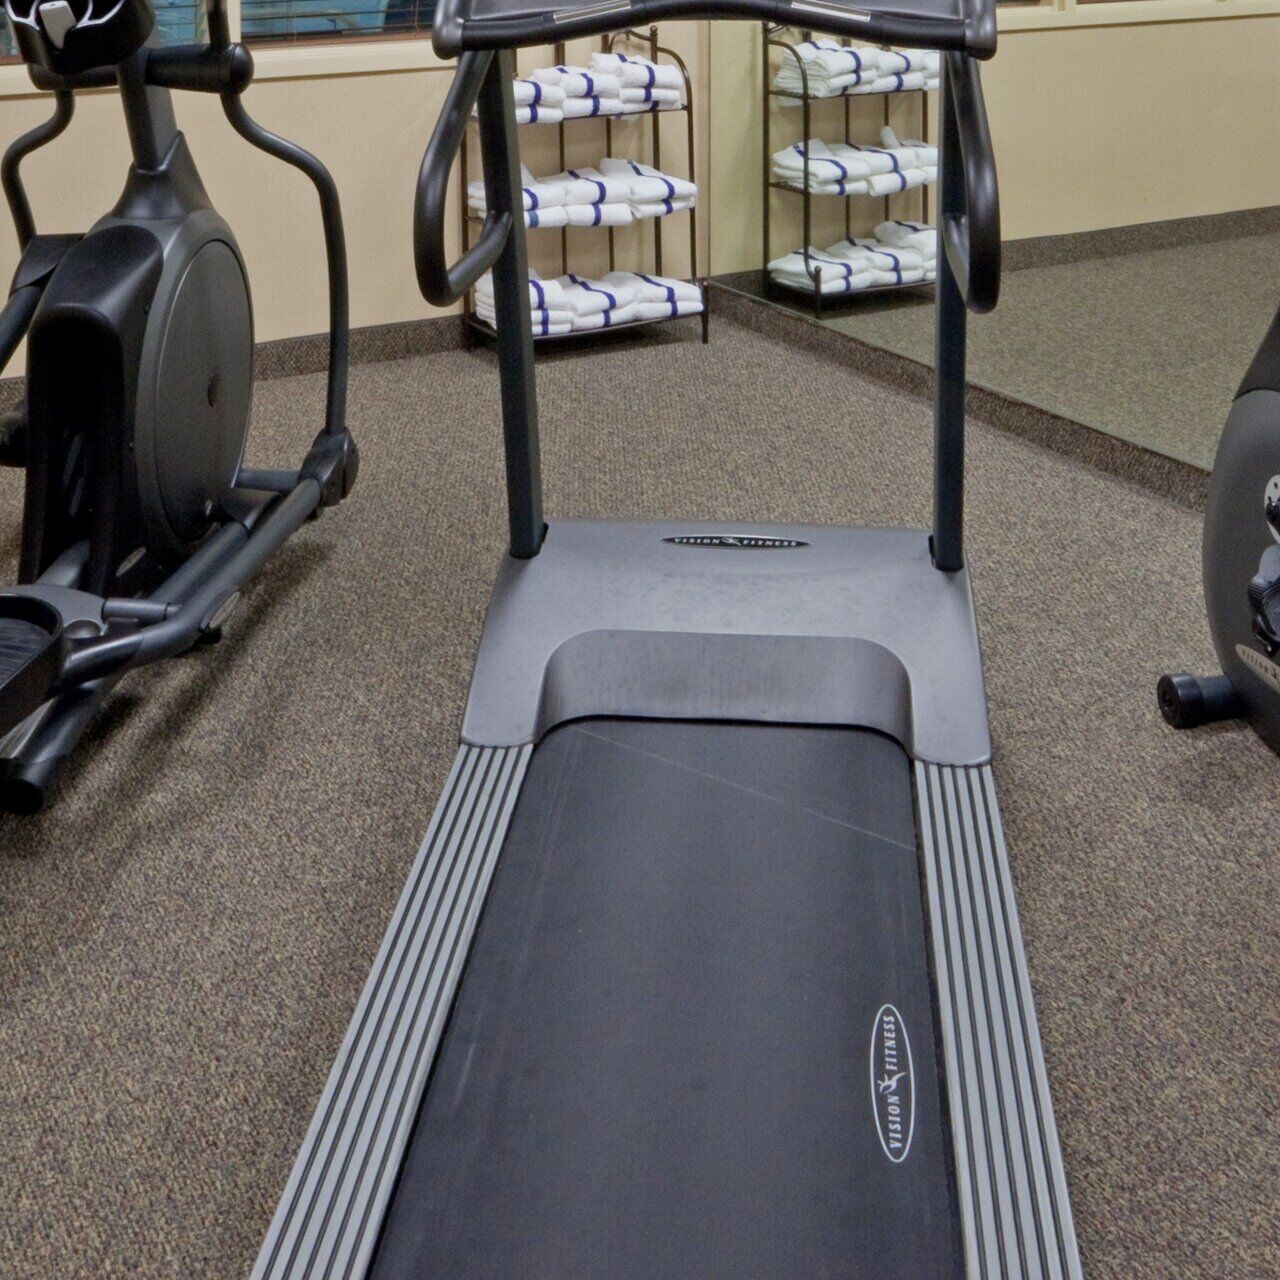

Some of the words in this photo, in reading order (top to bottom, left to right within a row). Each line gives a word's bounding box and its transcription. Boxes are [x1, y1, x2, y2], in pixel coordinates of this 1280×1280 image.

[674, 537, 720, 545] VISION
[742, 538, 797, 547] FITNESS
[1242, 648, 1269, 673] VISION
[883, 1015, 898, 1071] FITNESS
[888, 1094, 903, 1149] VISION
